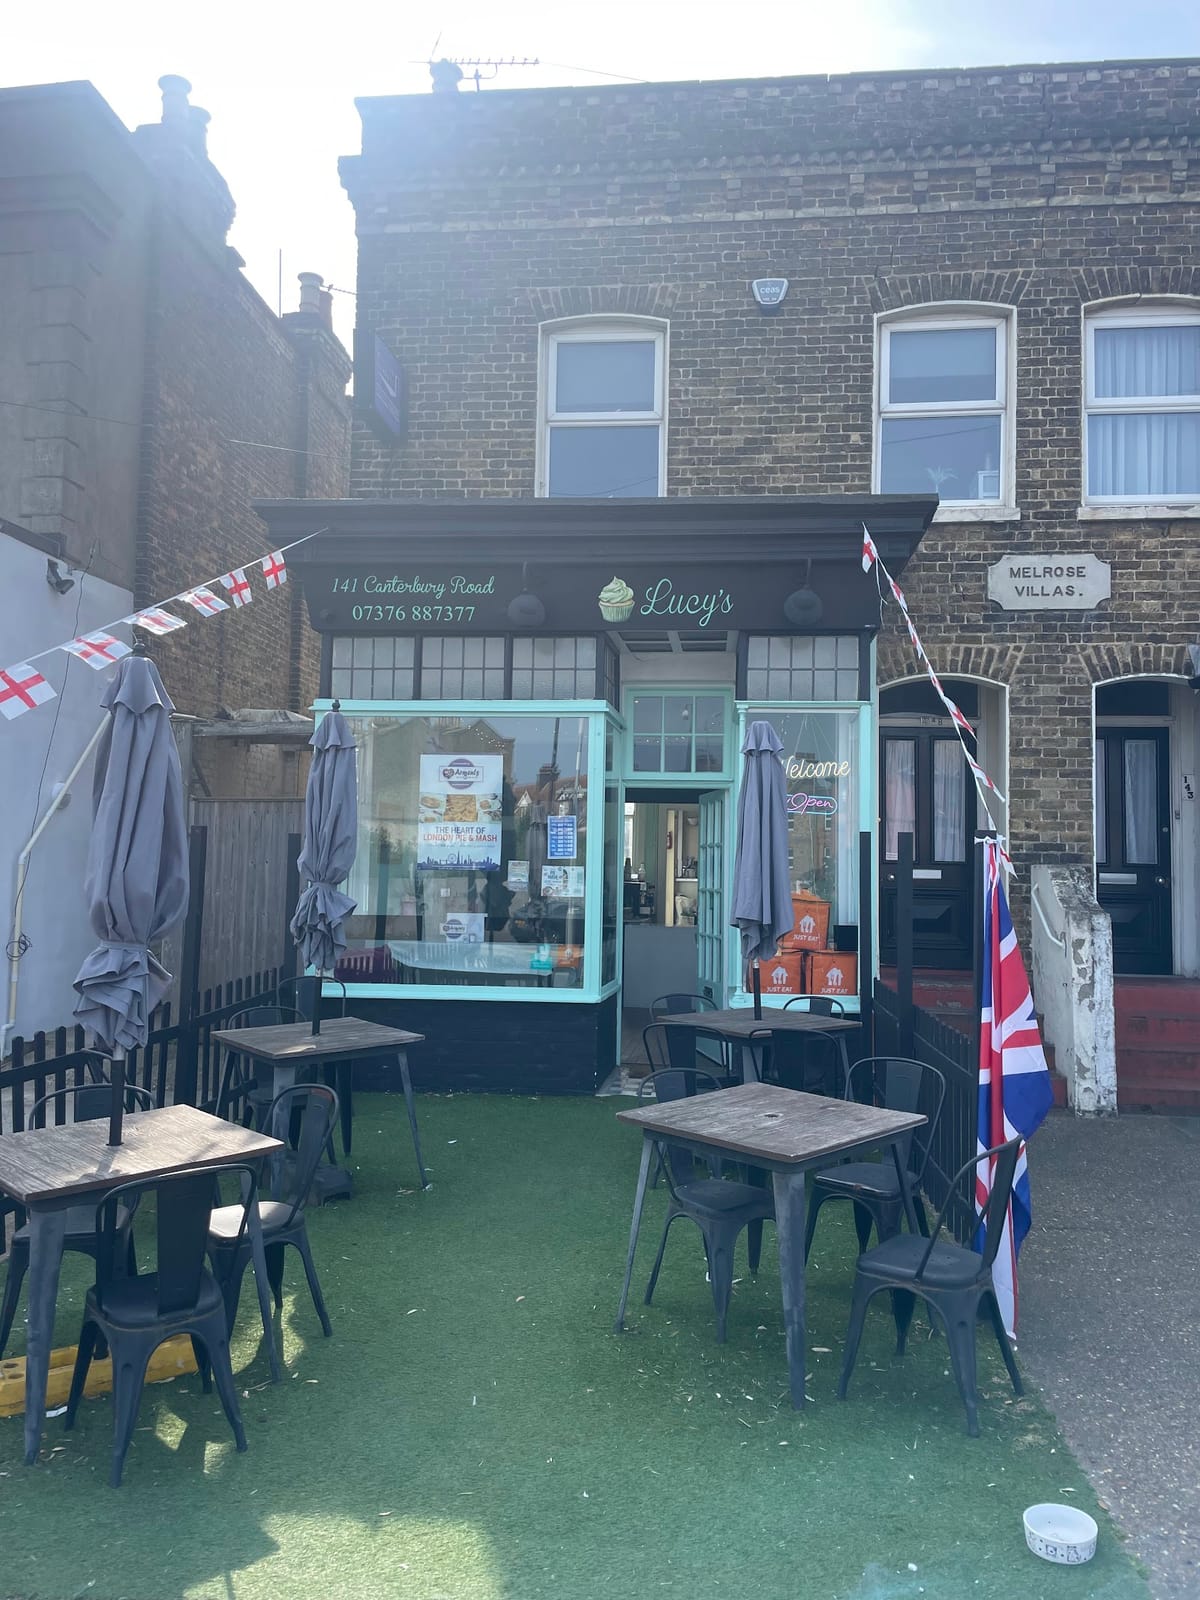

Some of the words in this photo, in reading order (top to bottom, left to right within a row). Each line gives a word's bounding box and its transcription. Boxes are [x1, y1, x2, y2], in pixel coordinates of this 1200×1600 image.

[1009, 566, 1086, 579] MELROSE
[332, 578, 358, 593] 141
[363, 575, 446, 600] Canterbury
[450, 575, 495, 594] Road
[1015, 585, 1083, 597] VILLAS.
[640, 578, 734, 627] Lucy's
[352, 605, 406, 621] 07376
[411, 605, 476, 621] 887377
[787, 792, 834, 815] Open
[435, 826, 450, 834] THE
[450, 826, 474, 834] HEART
[475, 826, 486, 834] OF
[423, 833, 454, 841] LONDON
[475, 834, 497, 842] MASH
